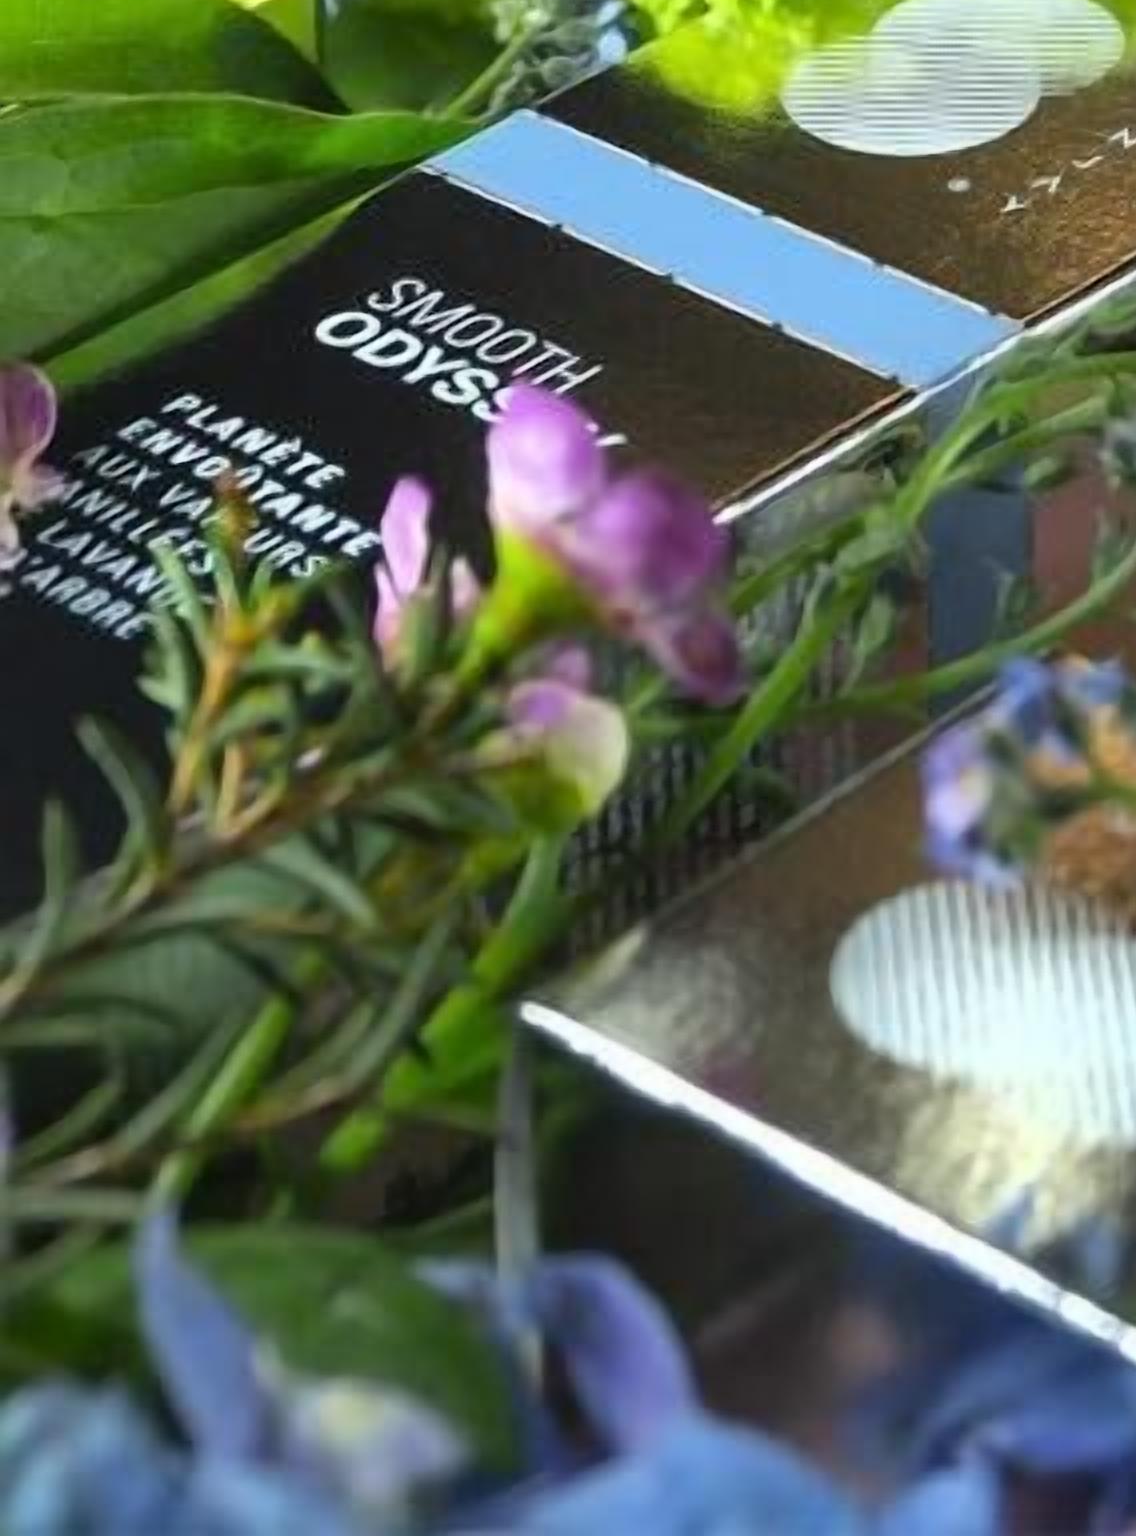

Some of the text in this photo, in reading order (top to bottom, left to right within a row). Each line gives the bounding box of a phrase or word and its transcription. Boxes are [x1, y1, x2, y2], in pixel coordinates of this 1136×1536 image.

[367, 277, 603, 395] SMOOTH
[72, 444, 163, 492] AUX
[160, 393, 346, 489] PLANÈTE
